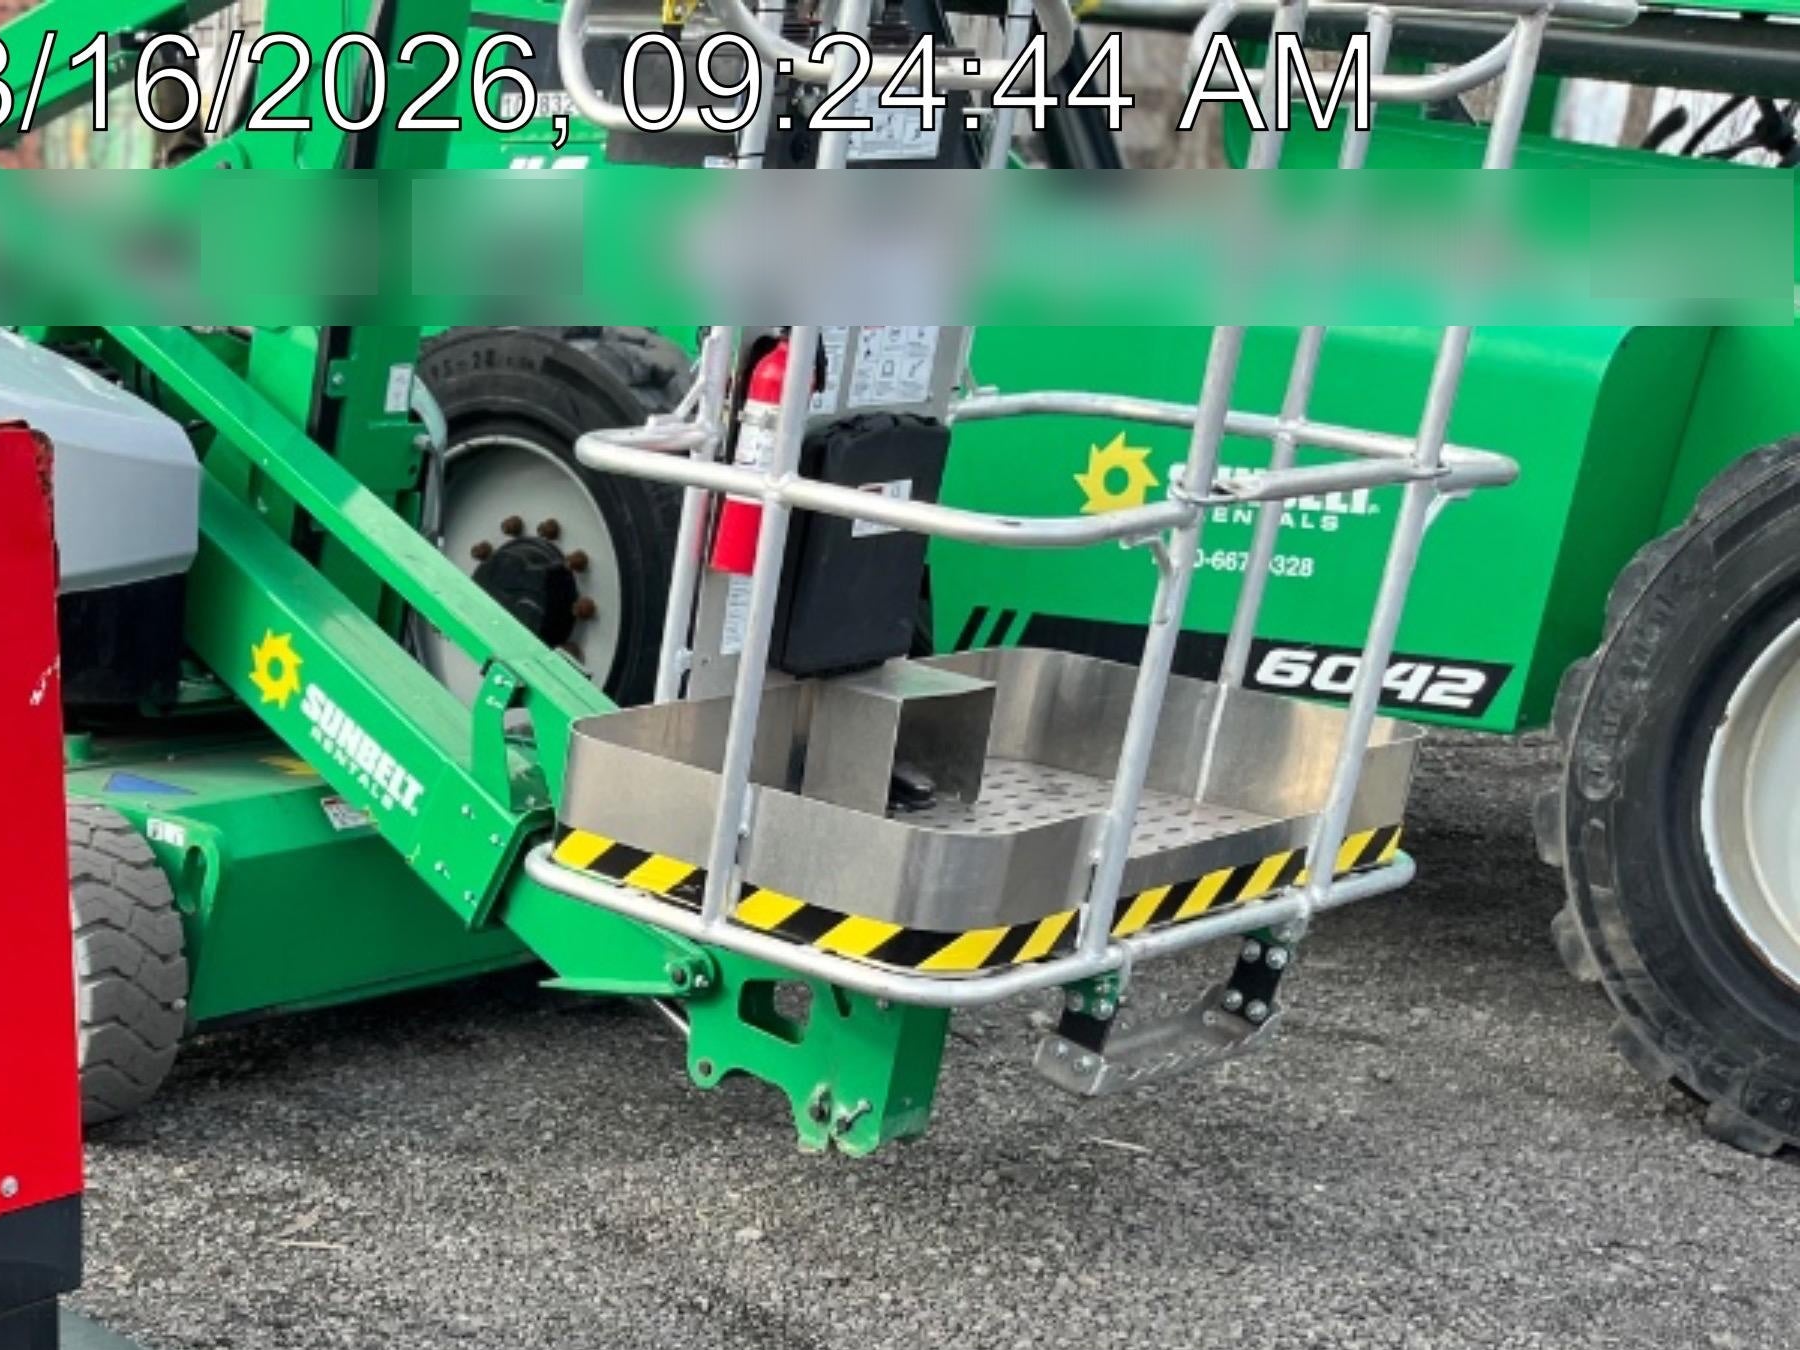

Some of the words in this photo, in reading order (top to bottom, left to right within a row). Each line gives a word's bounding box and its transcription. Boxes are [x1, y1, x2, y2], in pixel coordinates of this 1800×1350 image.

[1203, 505, 1339, 532] ENALS
[1255, 646, 1486, 710] 6042
[300, 682, 425, 812] SUNBELT
